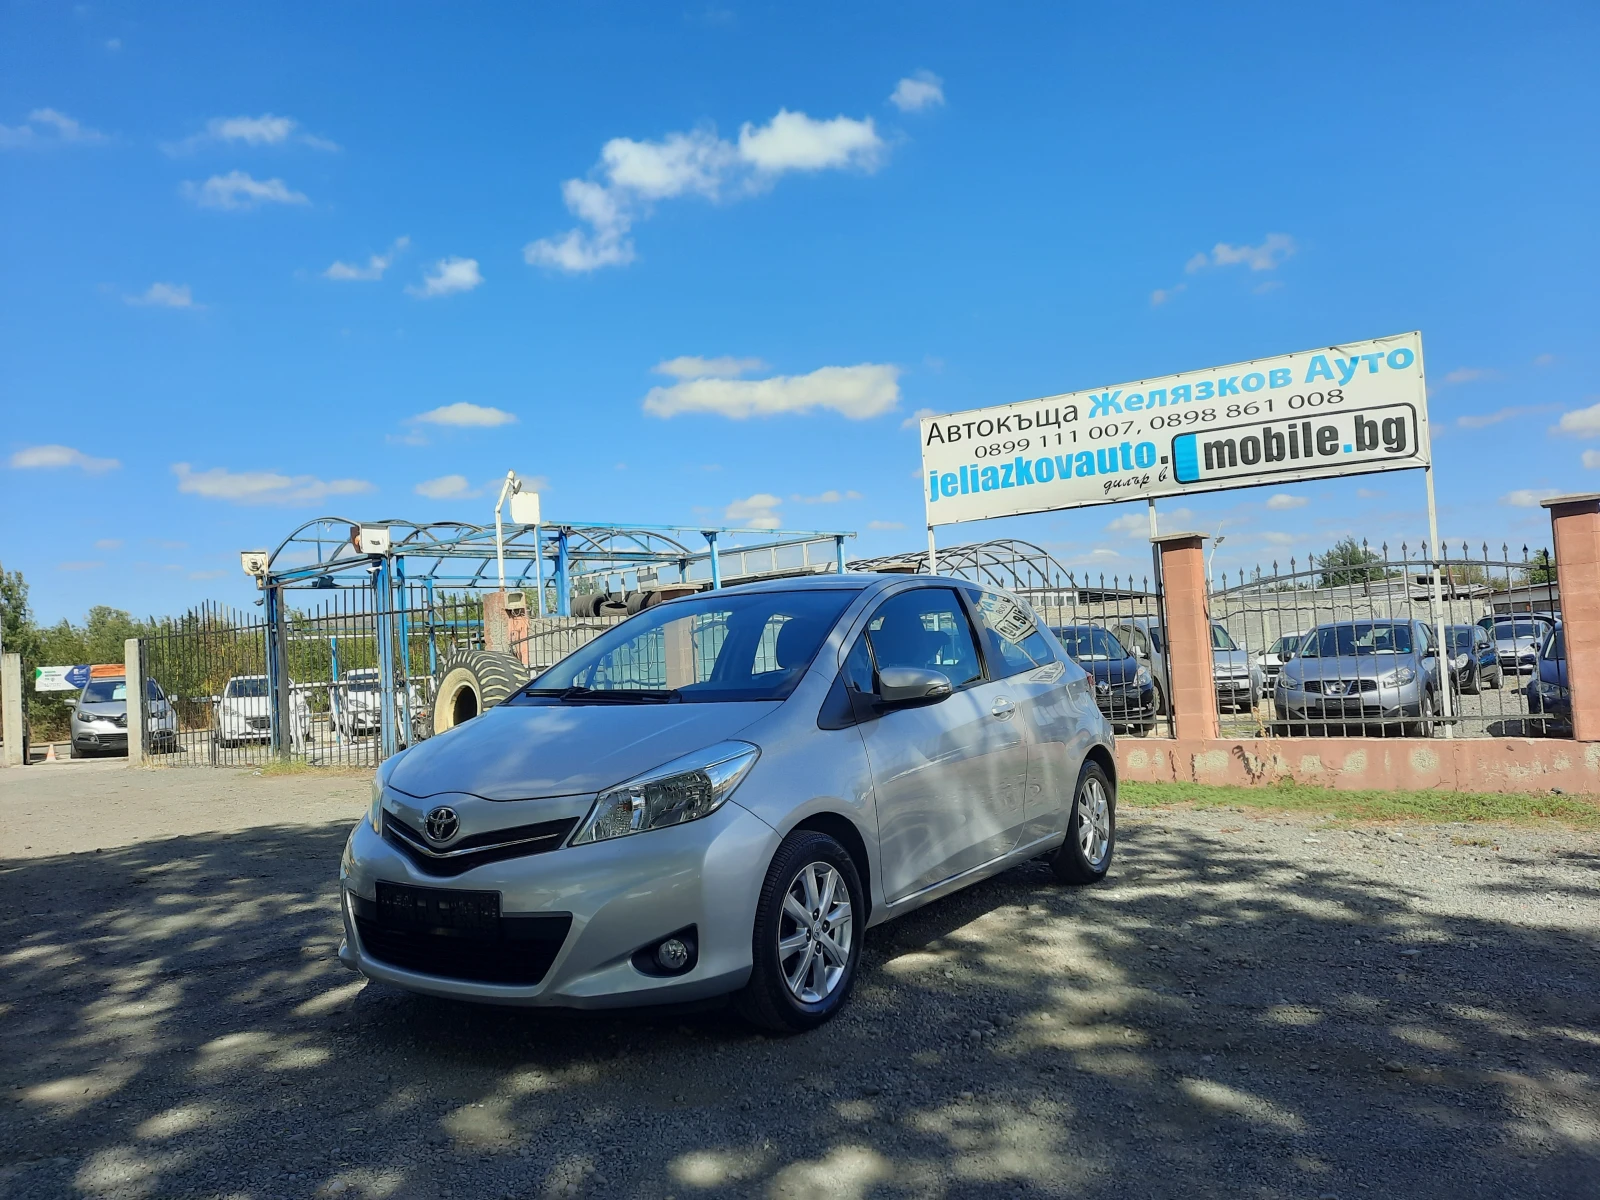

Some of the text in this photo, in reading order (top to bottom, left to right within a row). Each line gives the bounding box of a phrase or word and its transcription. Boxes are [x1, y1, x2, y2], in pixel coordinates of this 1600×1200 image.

[926, 348, 1415, 446] Автокъща Желязков Ауто
[974, 389, 1345, 458] 0899 111 007, 0898 861 008
[1203, 414, 1408, 470] mobile.bg
